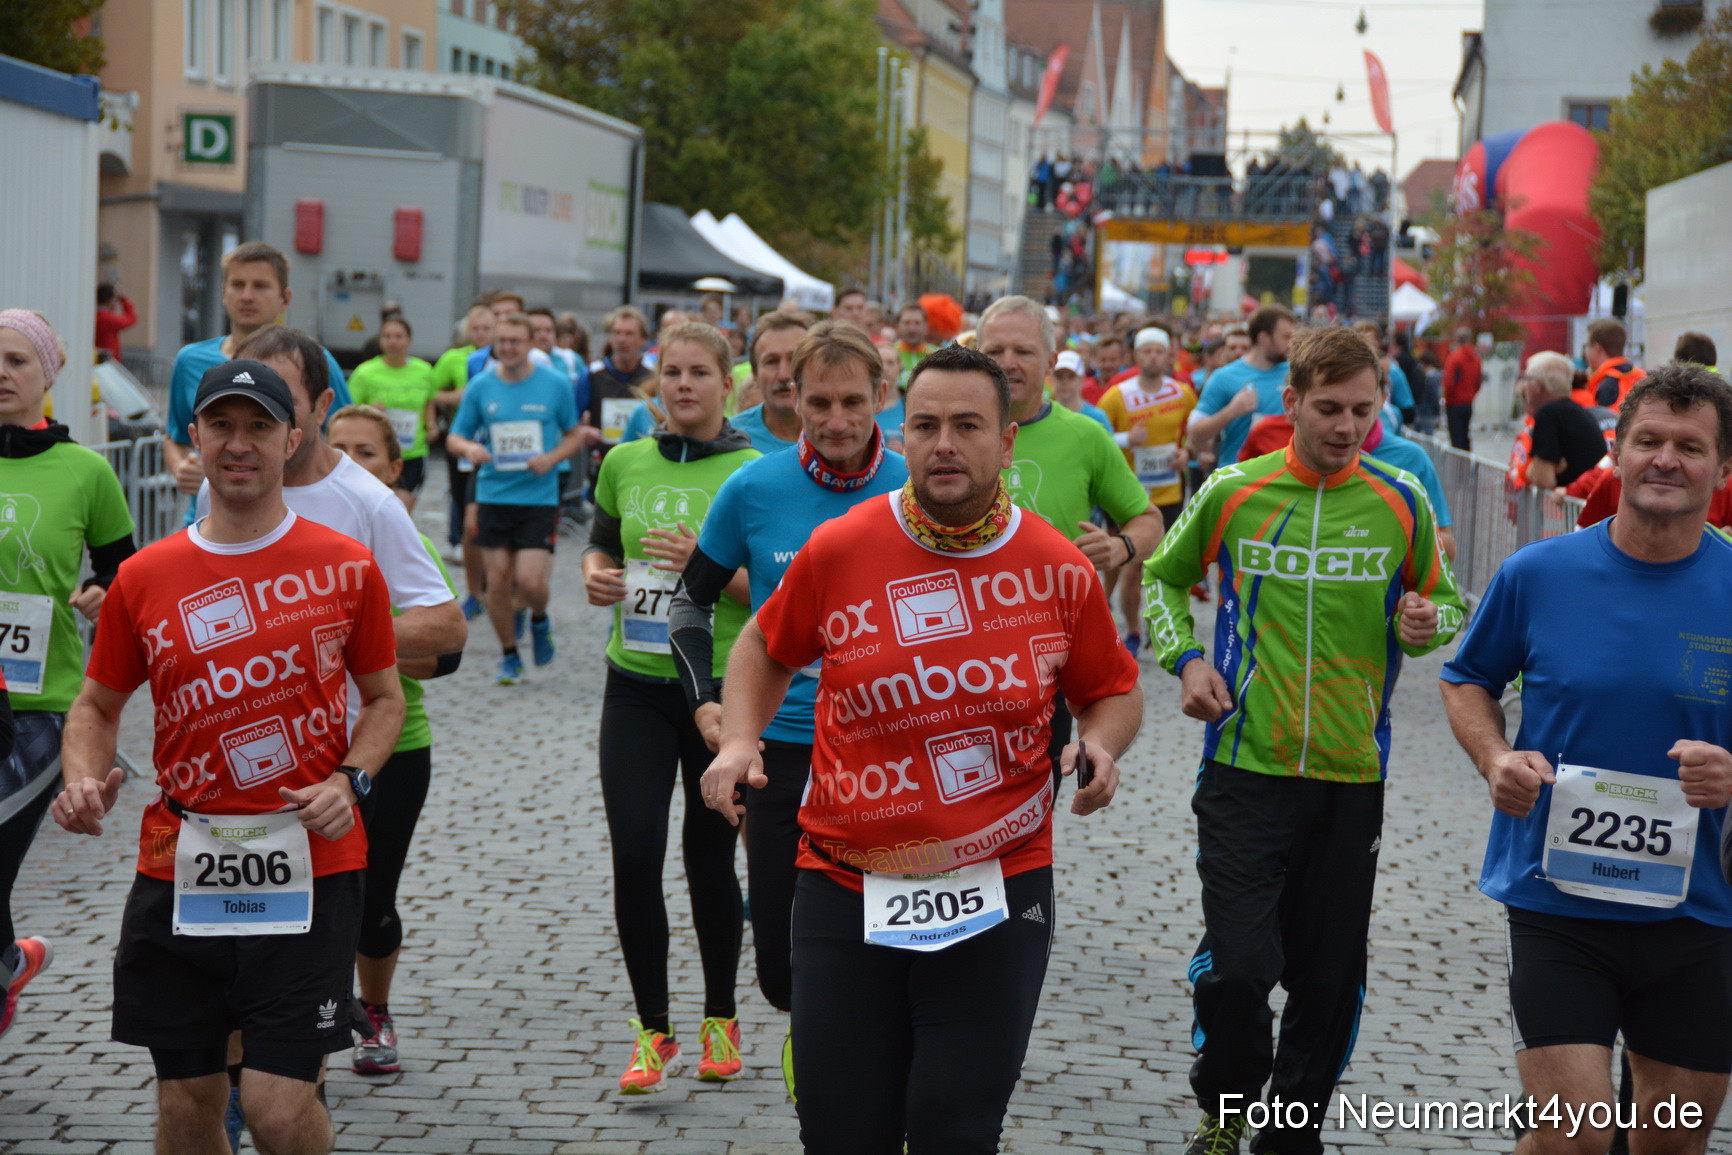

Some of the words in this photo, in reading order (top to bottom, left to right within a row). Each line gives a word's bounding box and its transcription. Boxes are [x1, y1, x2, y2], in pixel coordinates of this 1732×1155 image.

[190, 118, 229, 159] D
[822, 471, 870, 488] BAYERN
[1239, 538, 1391, 581] BOCK
[183, 583, 240, 612] raumbox
[253, 559, 371, 612] raum
[891, 576, 955, 598] raumbox
[971, 562, 1092, 611] raum
[265, 603, 335, 629] schenken
[982, 610, 1052, 632] schenken
[827, 652, 1027, 725] raumbox
[189, 705, 241, 732] wohnen
[252, 681, 309, 709] outdoor
[828, 725, 878, 748] schenken
[887, 709, 950, 732] wohnen
[964, 696, 1032, 716] outdoor
[225, 722, 281, 749] raumbox
[931, 731, 991, 755] raumbox
[1609, 783, 1658, 800] BOCK
[862, 800, 924, 822] outdoor
[221, 826, 267, 838] BOCK
[953, 804, 1039, 860] raumbox
[1568, 808, 1672, 856] 2235
[195, 850, 291, 887] 2506
[1592, 862, 1640, 881] Hubert
[223, 900, 266, 914] Tobias
[886, 887, 984, 926] 2505
[1022, 911, 1046, 923] adidas
[910, 925, 967, 941] Andreas
[316, 1020, 335, 1029] adidas
